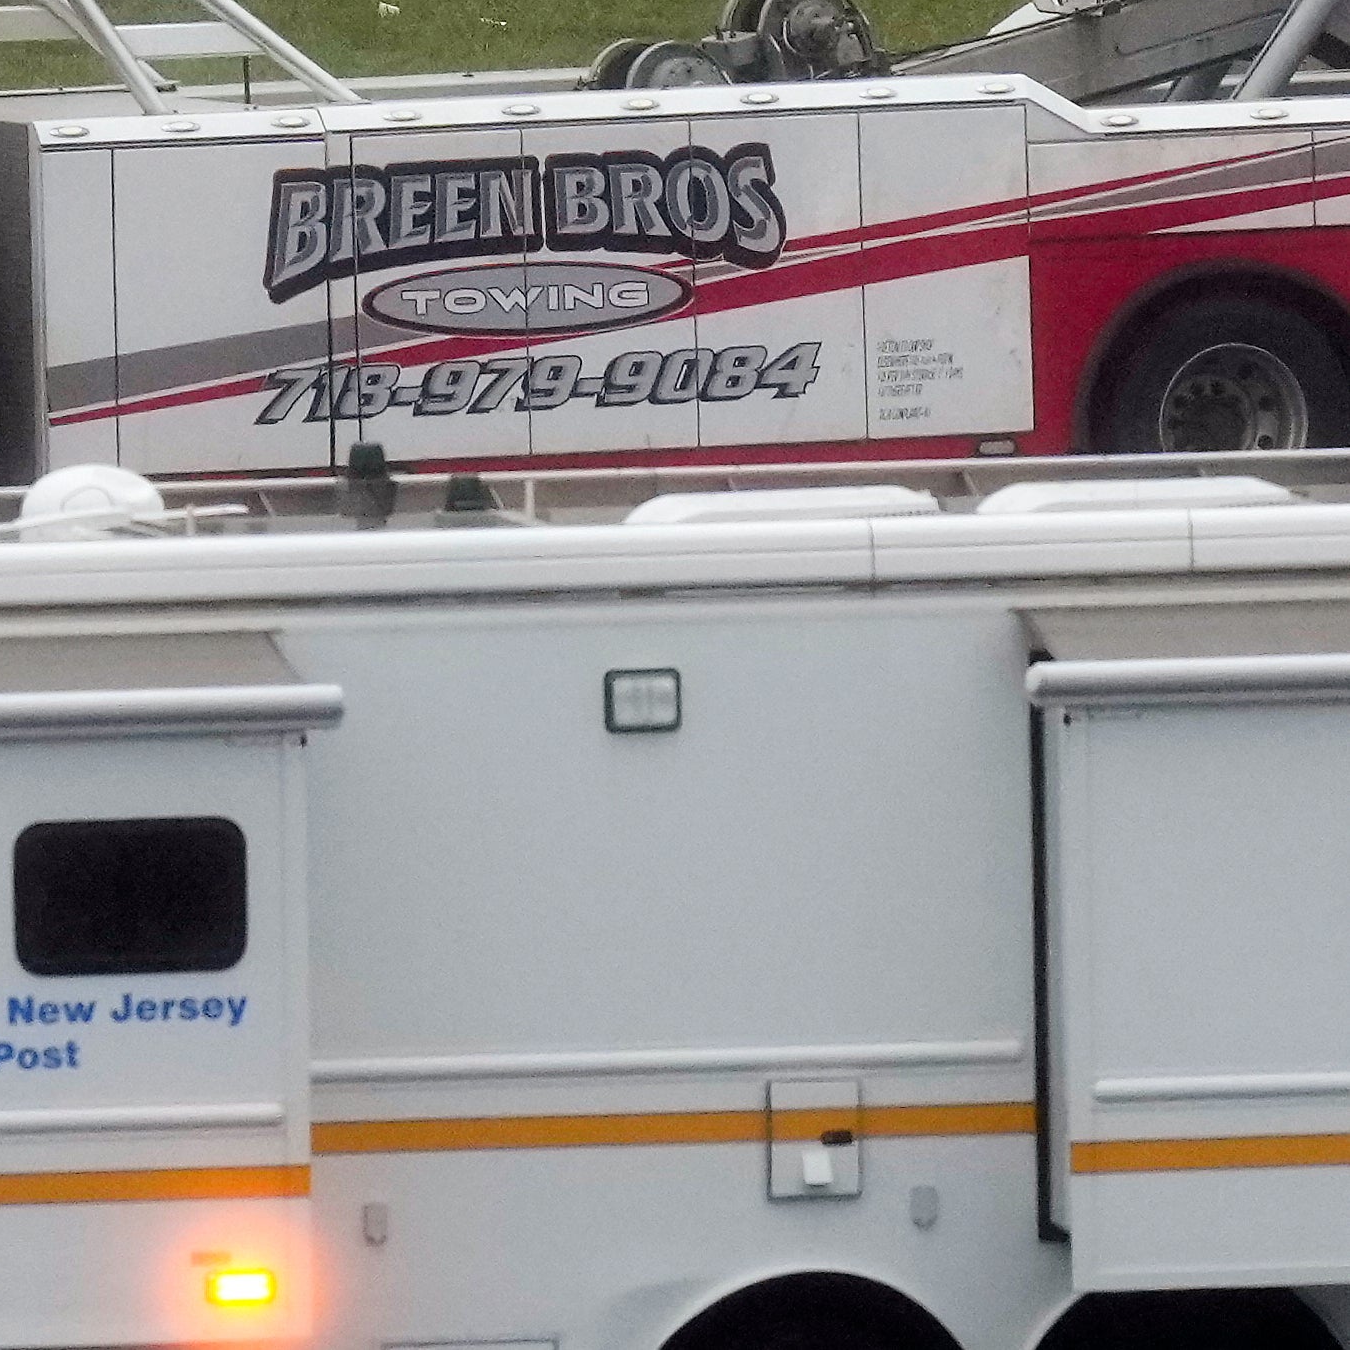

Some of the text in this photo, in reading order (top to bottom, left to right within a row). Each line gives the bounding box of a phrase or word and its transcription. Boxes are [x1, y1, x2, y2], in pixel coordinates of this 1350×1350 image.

[266, 147, 787, 297] BREEN BROS
[400, 280, 651, 317] TOWING
[254, 341, 822, 425] 718-979-9084
[7, 995, 97, 1026] New
[110, 992, 248, 1027] Jersey
